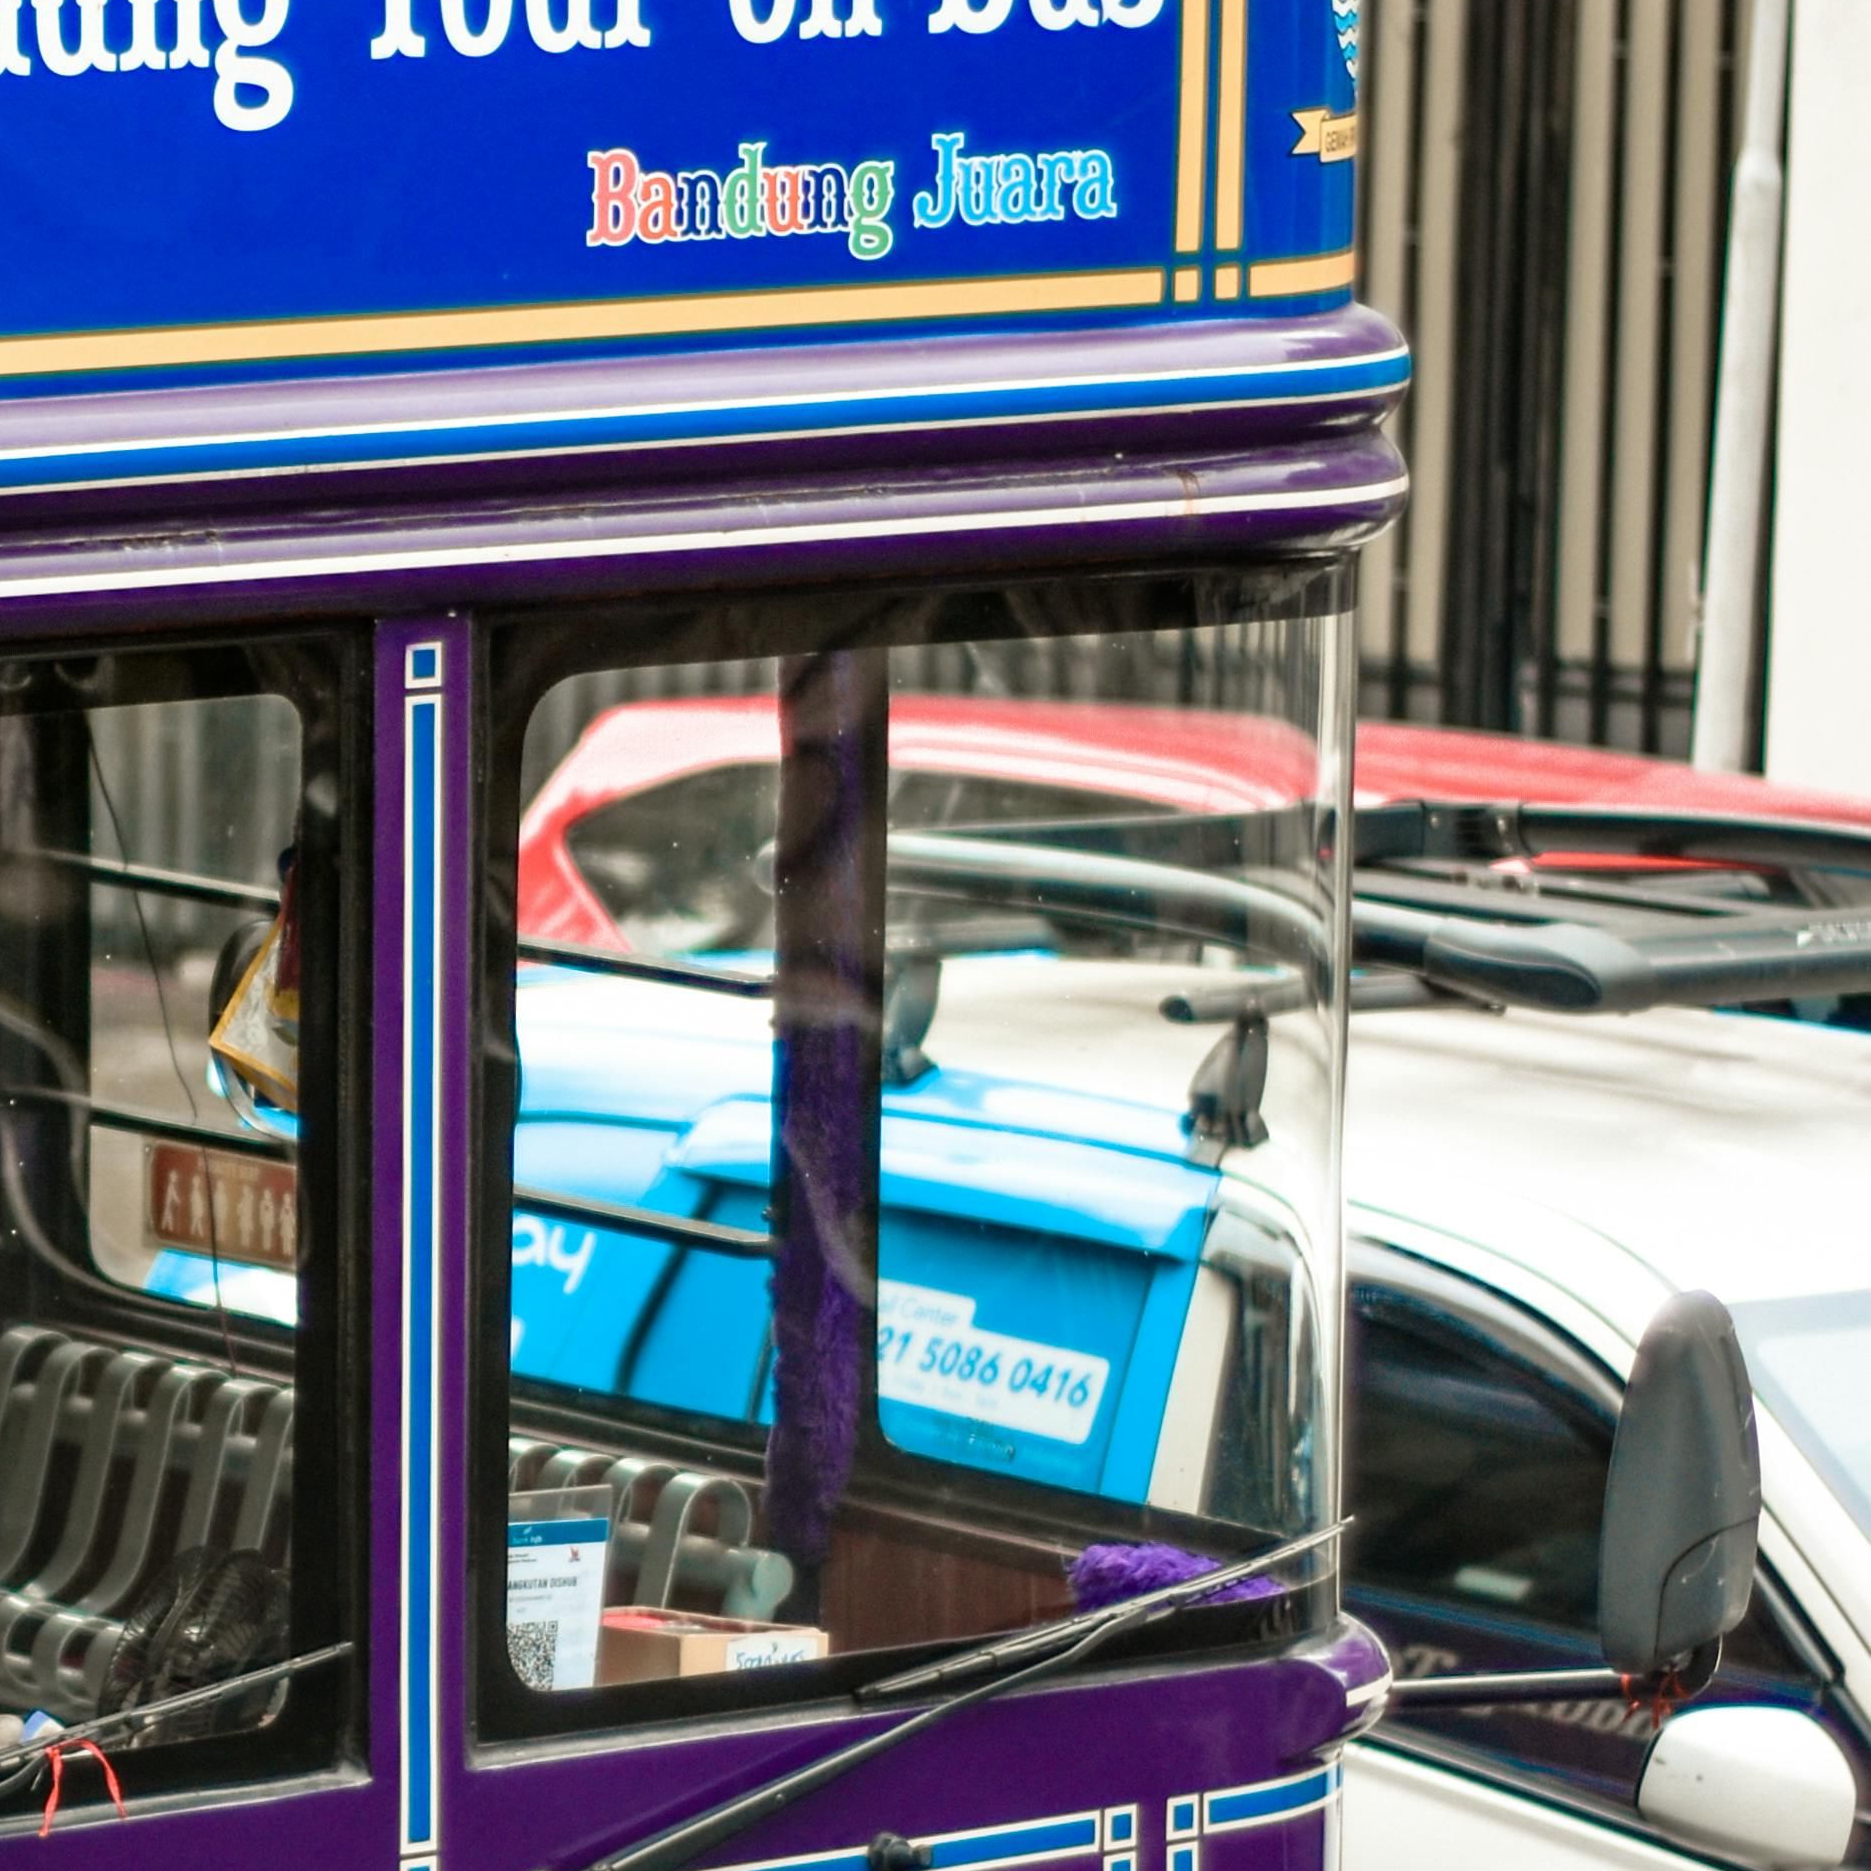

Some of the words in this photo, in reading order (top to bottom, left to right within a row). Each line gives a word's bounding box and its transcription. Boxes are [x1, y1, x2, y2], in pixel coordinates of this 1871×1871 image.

[586, 142, 894, 259] Bandung
[913, 132, 1117, 228] Juara
[919, 1336, 1003, 1386] 5086
[1008, 1357, 1092, 1409] 0416
